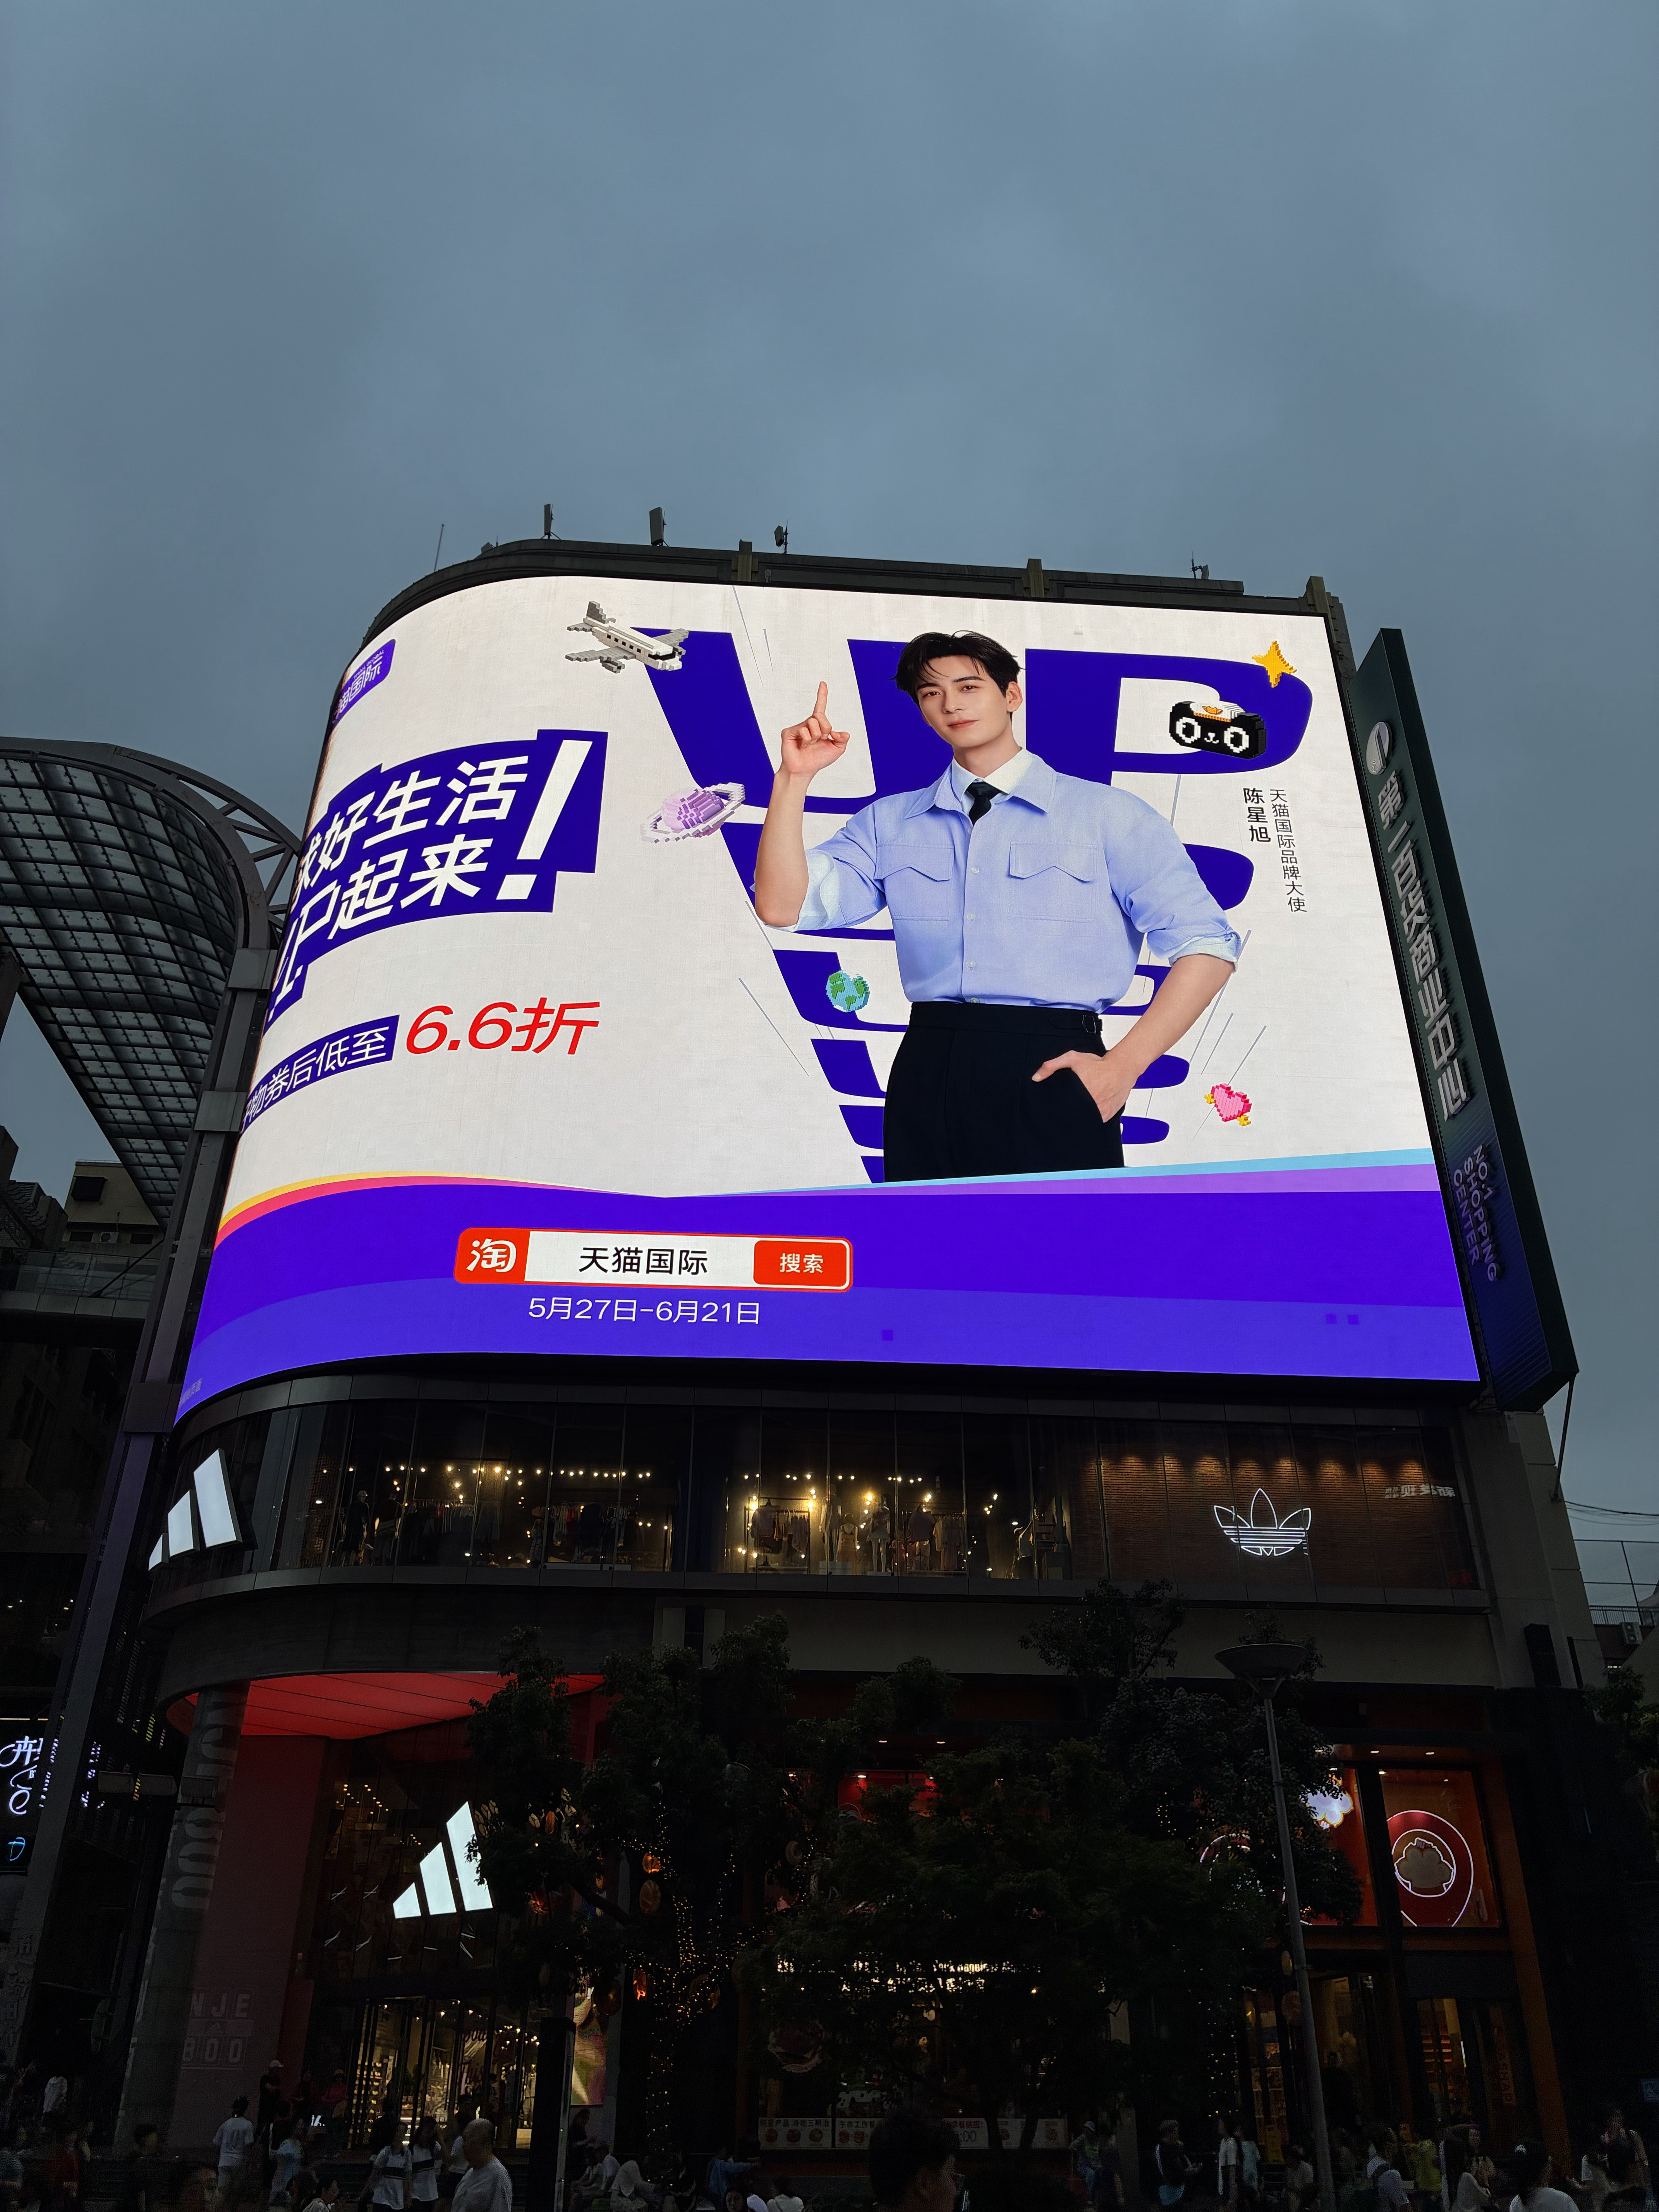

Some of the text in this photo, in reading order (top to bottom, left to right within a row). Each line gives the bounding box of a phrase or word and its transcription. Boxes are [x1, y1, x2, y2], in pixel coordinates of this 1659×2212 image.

[332, 656, 383, 722] 猫国际
[1243, 788, 1271, 842] 陈星旭
[1270, 789, 1307, 913] 天猫国际品牌大使
[1378, 770, 1471, 1121] 第一百货商业中心
[406, 997, 600, 1055] 6.6折
[1453, 1169, 1480, 1266] CENTER
[1464, 1156, 1498, 1281] SHOPPING
[466, 1238, 824, 1275] 淘 天猫国际 搜索
[528, 1297, 759, 1324] 5月27日-6月21日
